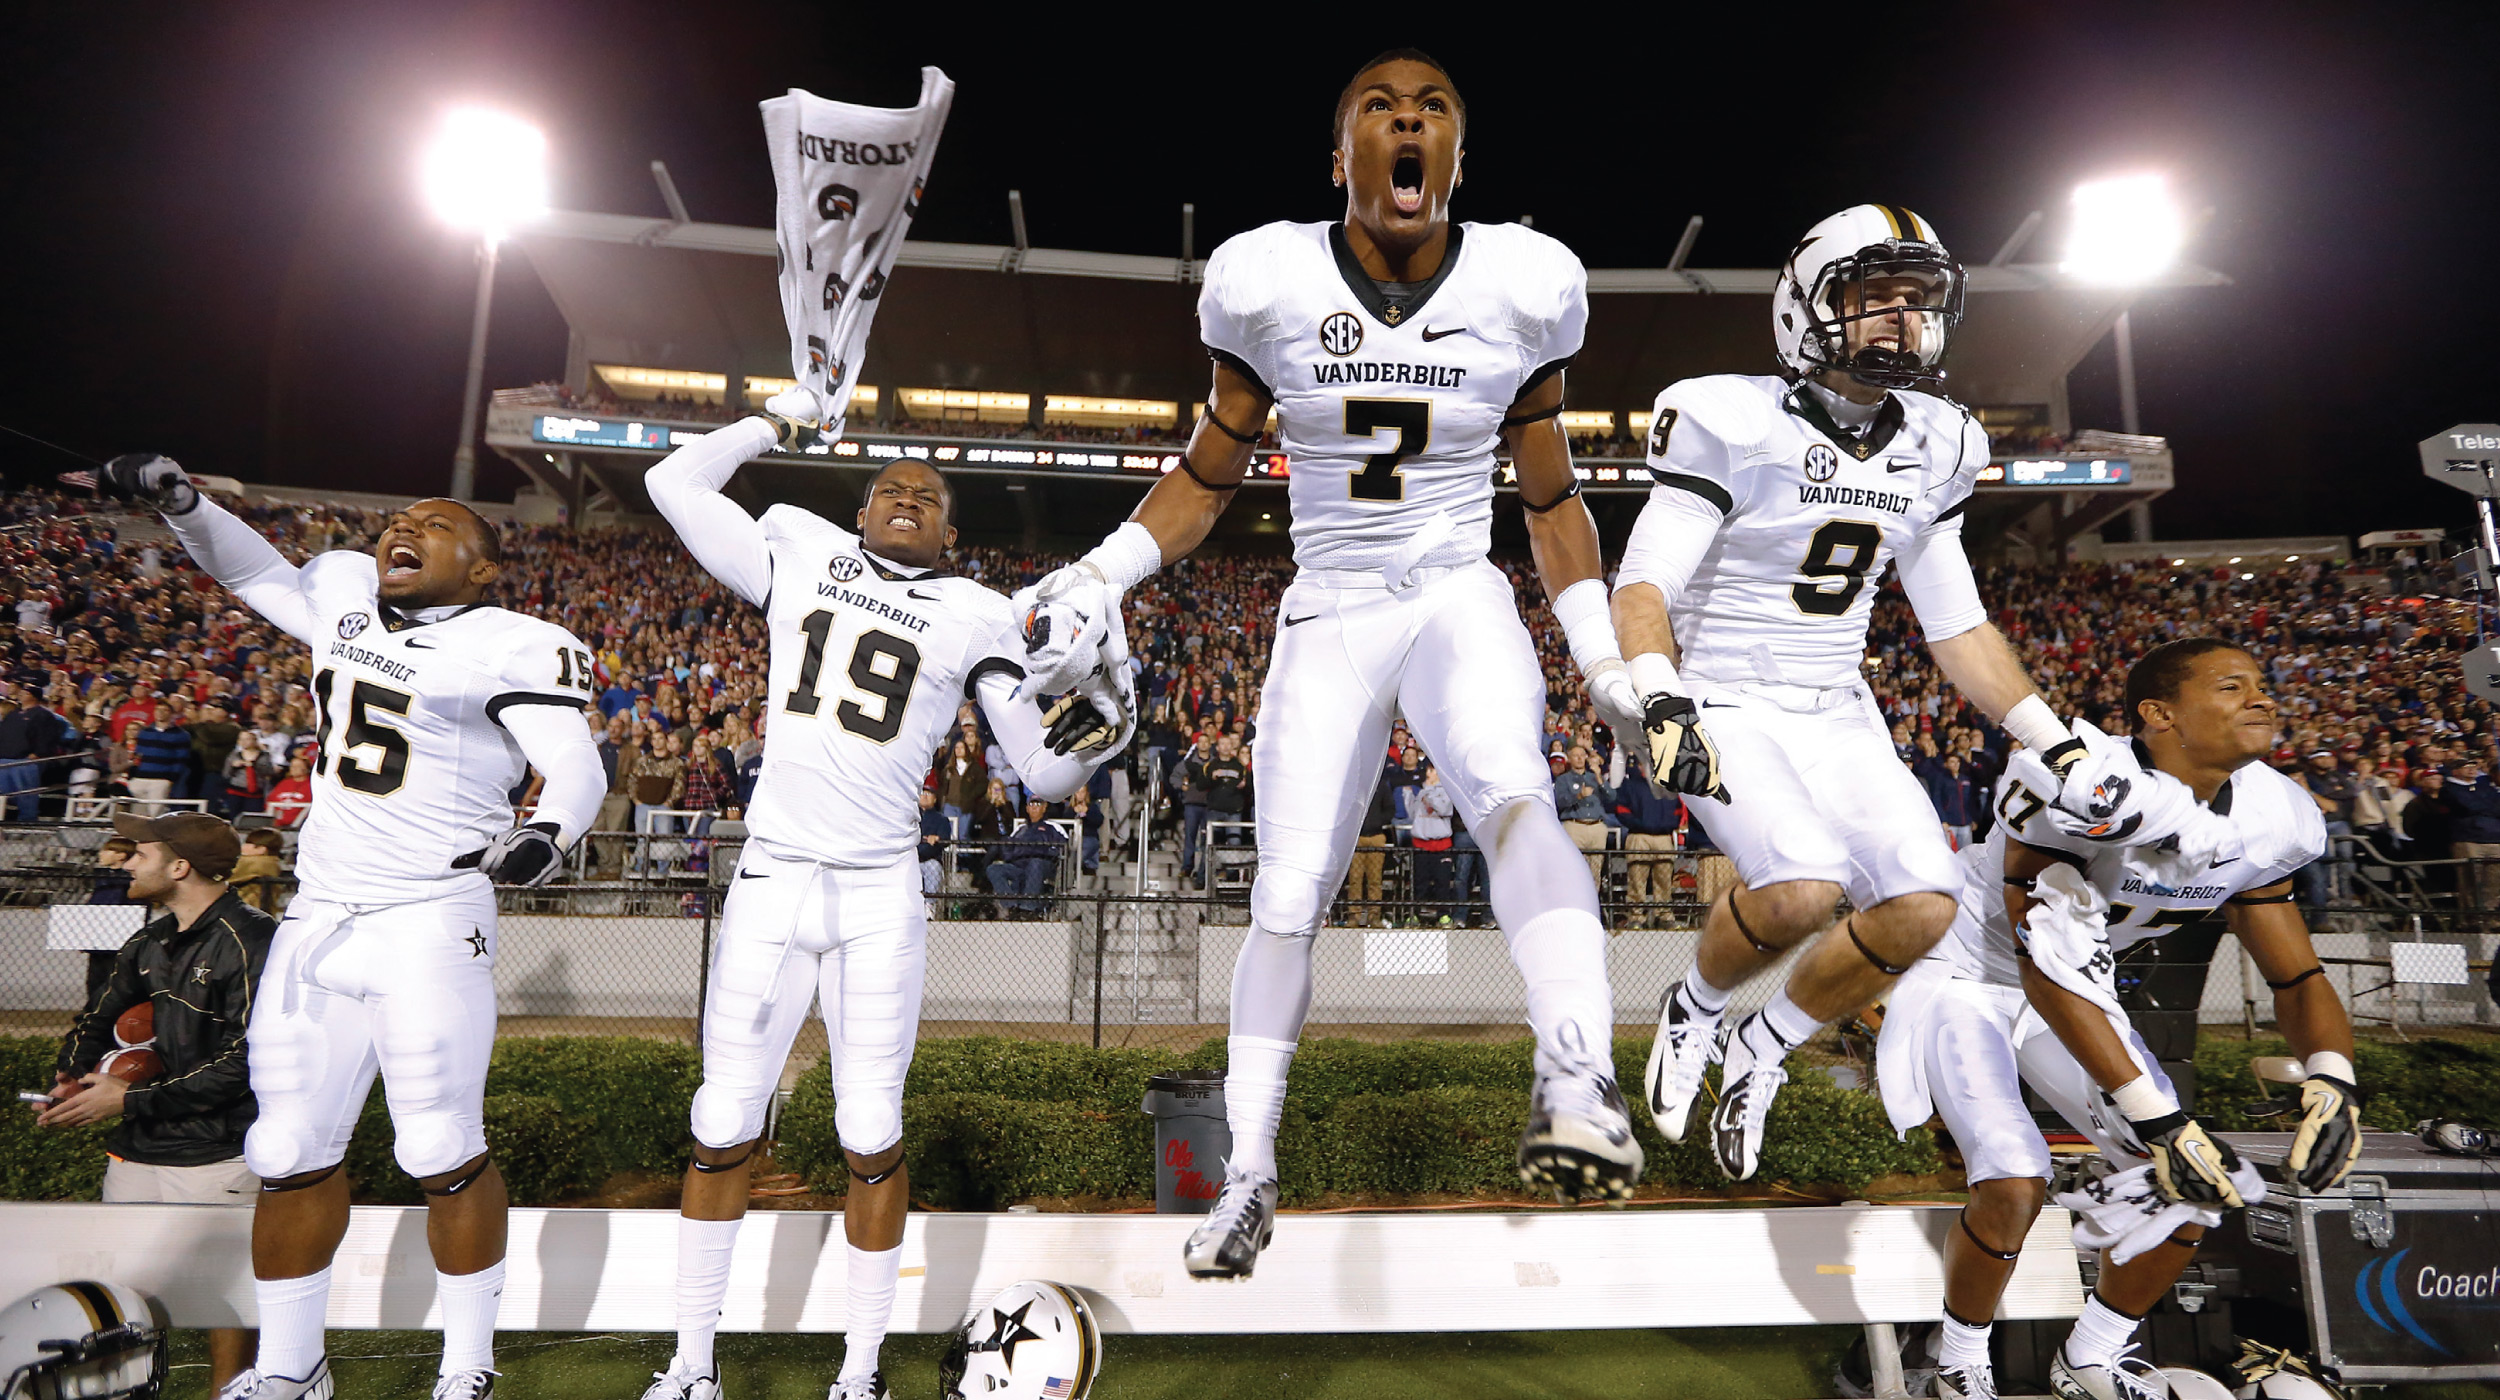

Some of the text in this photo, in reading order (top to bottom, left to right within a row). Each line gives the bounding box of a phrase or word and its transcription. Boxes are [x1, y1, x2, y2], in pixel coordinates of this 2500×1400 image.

[1322, 313, 1361, 355] SEC
[1313, 362, 1467, 388] VANDERBILT
[1343, 397, 1433, 503] 7
[1651, 408, 1679, 458] 9
[1806, 446, 1837, 482] SEC
[1799, 485, 1913, 515] VANDERBILT
[830, 557, 862, 581] SEC
[1789, 518, 1884, 617] 9
[339, 613, 369, 640] SEC
[816, 582, 931, 634] VANDERBILT
[330, 641, 417, 682] VANDERBILT
[556, 646, 593, 692] 15
[783, 607, 924, 747] 19
[315, 666, 415, 799] 15
[1998, 777, 2047, 834] 17
[1175, 1090, 1211, 1099] BRUTE
[1165, 1139, 1194, 1168] Ole
